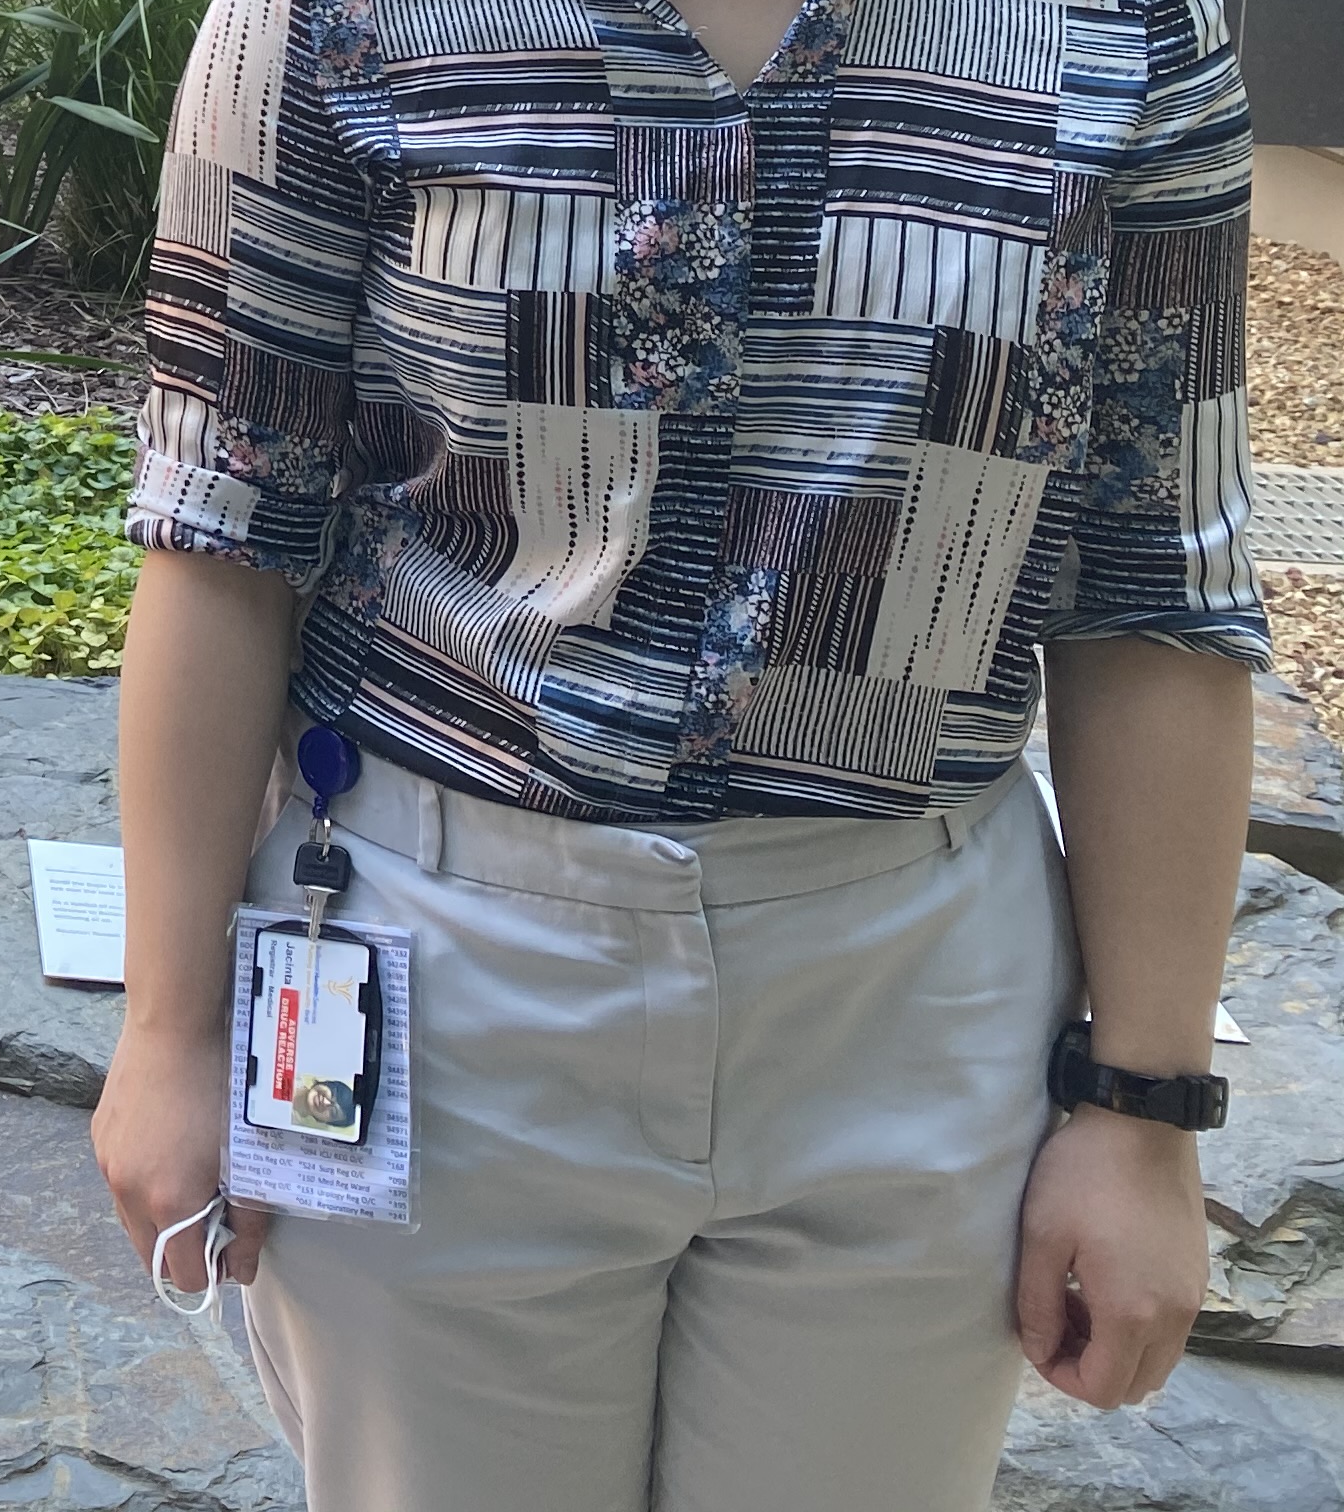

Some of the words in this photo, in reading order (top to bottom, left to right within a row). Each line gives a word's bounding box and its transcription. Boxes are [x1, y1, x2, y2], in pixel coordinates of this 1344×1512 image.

[268, 940, 278, 978] Registrar
[284, 942, 296, 985] Jacinta
[266, 986, 275, 1018] Medical
[279, 998, 289, 1029] DRUG
[275, 1032, 288, 1090] REACTION
[285, 1019, 296, 1071] ADVERSE
[360, 1208, 374, 1217] Reg
